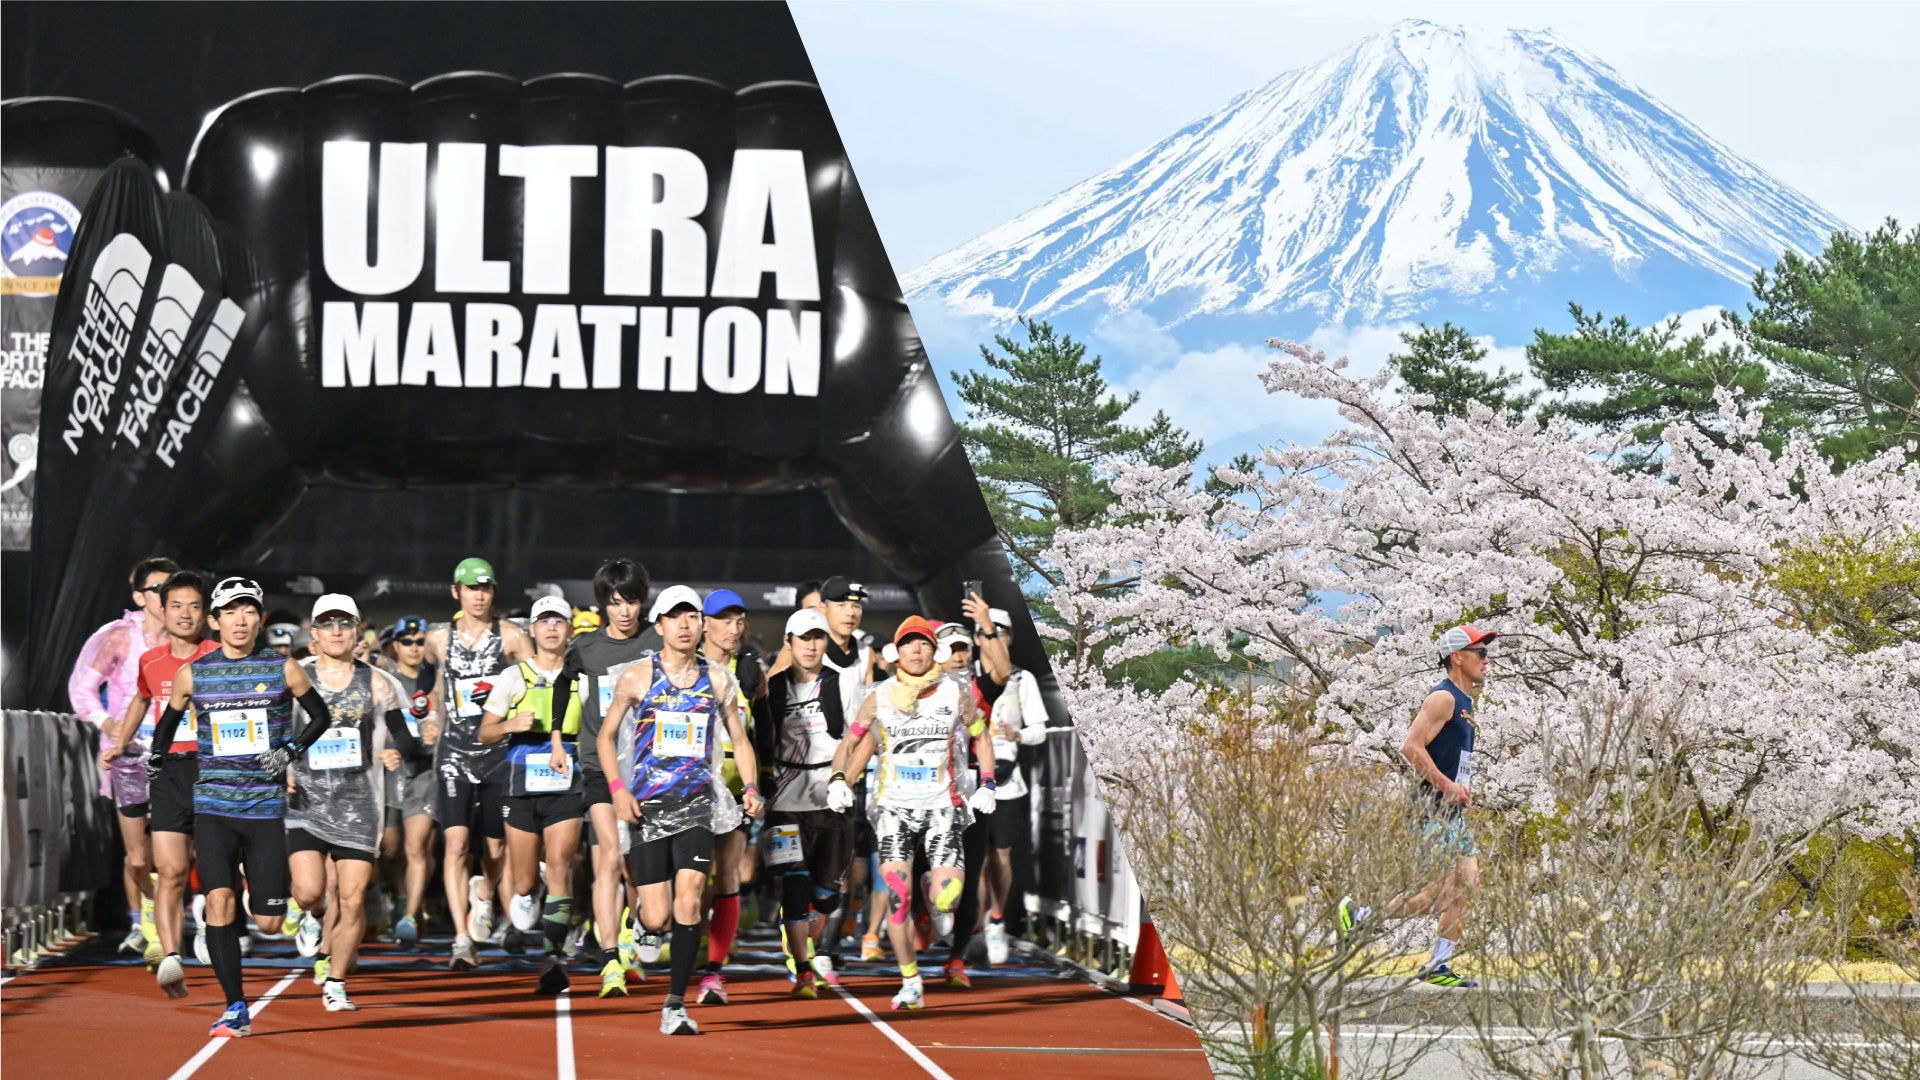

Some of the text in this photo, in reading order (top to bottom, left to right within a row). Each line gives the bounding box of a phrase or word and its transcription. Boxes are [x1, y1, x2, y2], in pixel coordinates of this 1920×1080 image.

[321, 140, 821, 301] ULTRA
[10, 332, 51, 352] THE
[68, 282, 104, 365] THE
[321, 301, 822, 397] MARATHON
[62, 302, 117, 456] NORTH
[88, 317, 131, 435] FACE
[123, 341, 175, 449] FACE
[155, 364, 214, 468] FACE
[221, 728, 246, 739] 1102
